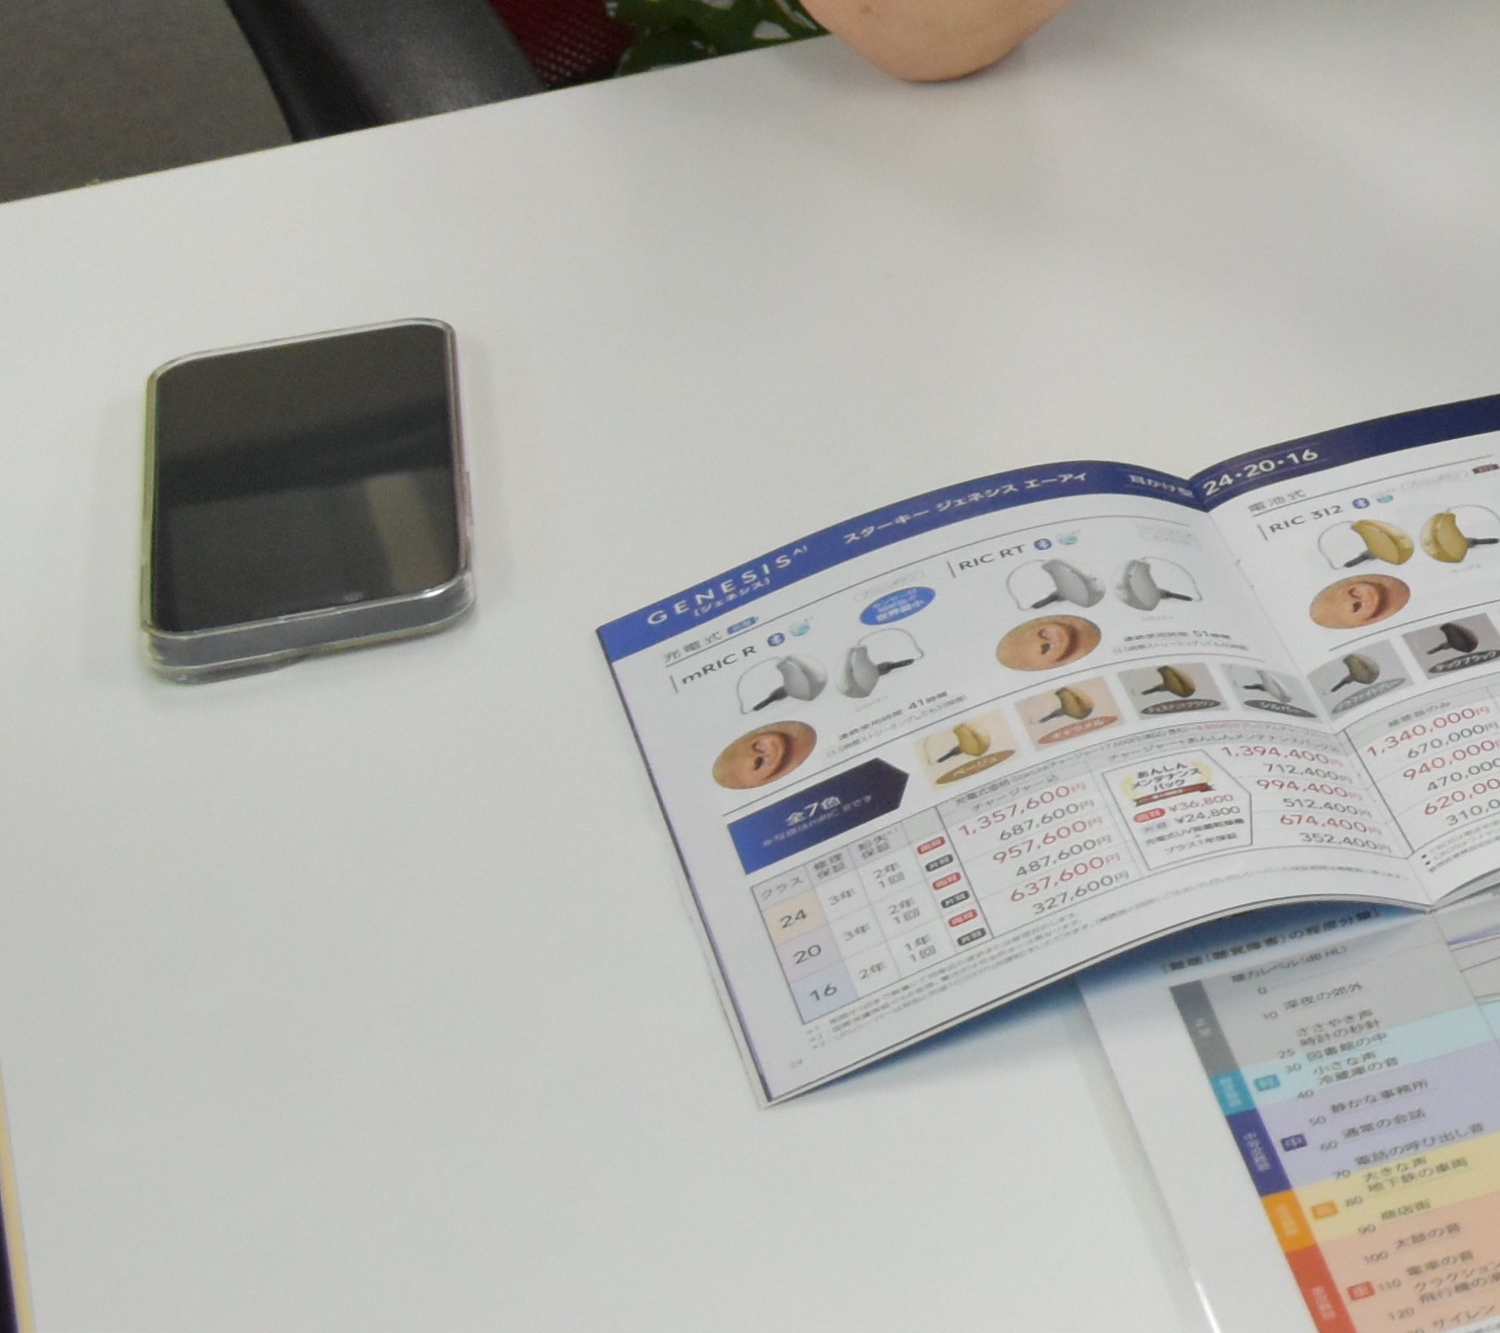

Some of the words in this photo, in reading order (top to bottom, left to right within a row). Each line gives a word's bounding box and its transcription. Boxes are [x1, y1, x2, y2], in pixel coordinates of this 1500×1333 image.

[843, 510, 929, 544] スターキー
[936, 485, 1018, 511] ジェネシス
[1024, 473, 1087, 489] エーアイ
[1270, 515, 1306, 534] RIC
[1311, 505, 1344, 521] 312
[959, 553, 995, 570] RIC
[1000, 544, 1025, 558] RT
[647, 555, 791, 625] GENESIS
[682, 654, 738, 684] mRIC
[742, 646, 757, 658] R
[1367, 705, 1491, 758] 1,340,000円
[1406, 720, 1500, 760] 670,000円
[786, 796, 842, 826] 全7色
[958, 780, 1087, 837] 1,357,600円
[999, 798, 1095, 841] 687,600円
[1169, 794, 1234, 813] ¥36,800
[1175, 805, 1241, 825] ¥24,800
[993, 815, 1104, 864] 957,600円
[1016, 833, 1113, 877] 487,600円
[1010, 851, 1121, 903] 637,600円
[1032, 869, 1129, 914] 327,600円
[779, 909, 808, 929] 24
[793, 943, 822, 964] 20
[810, 983, 838, 1001] 16
